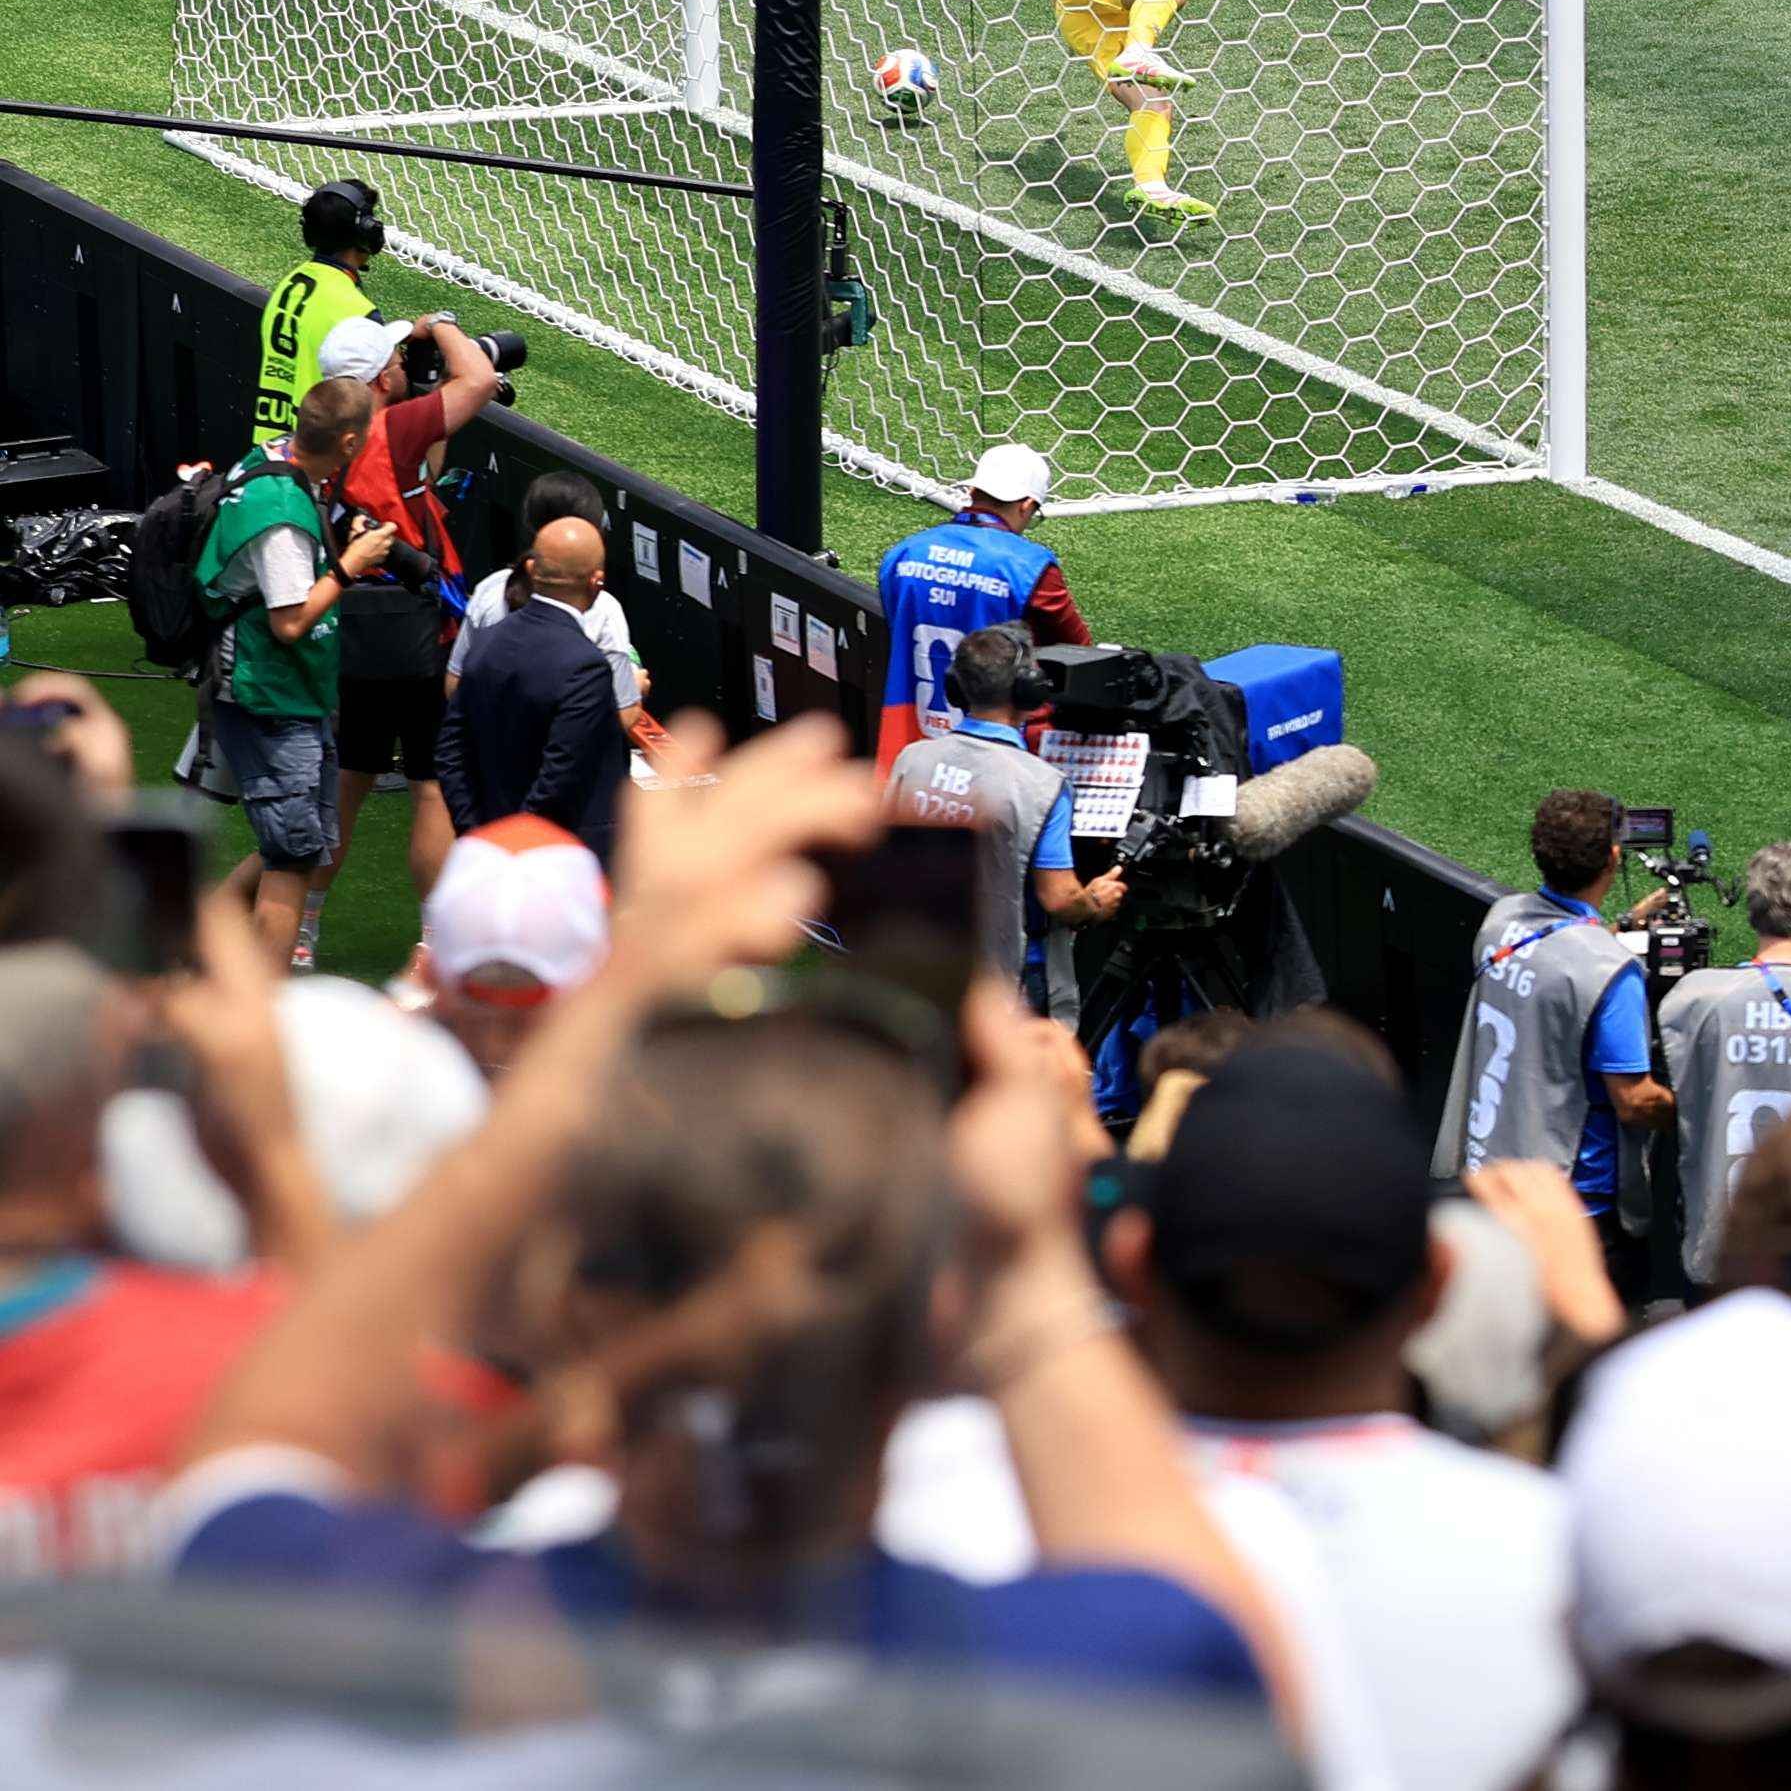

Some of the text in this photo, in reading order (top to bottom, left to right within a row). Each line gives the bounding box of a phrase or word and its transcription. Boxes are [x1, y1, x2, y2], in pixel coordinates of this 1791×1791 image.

[927, 543, 975, 570] TEAM
[928, 586, 957, 608] SUI
[930, 761, 974, 797] HB
